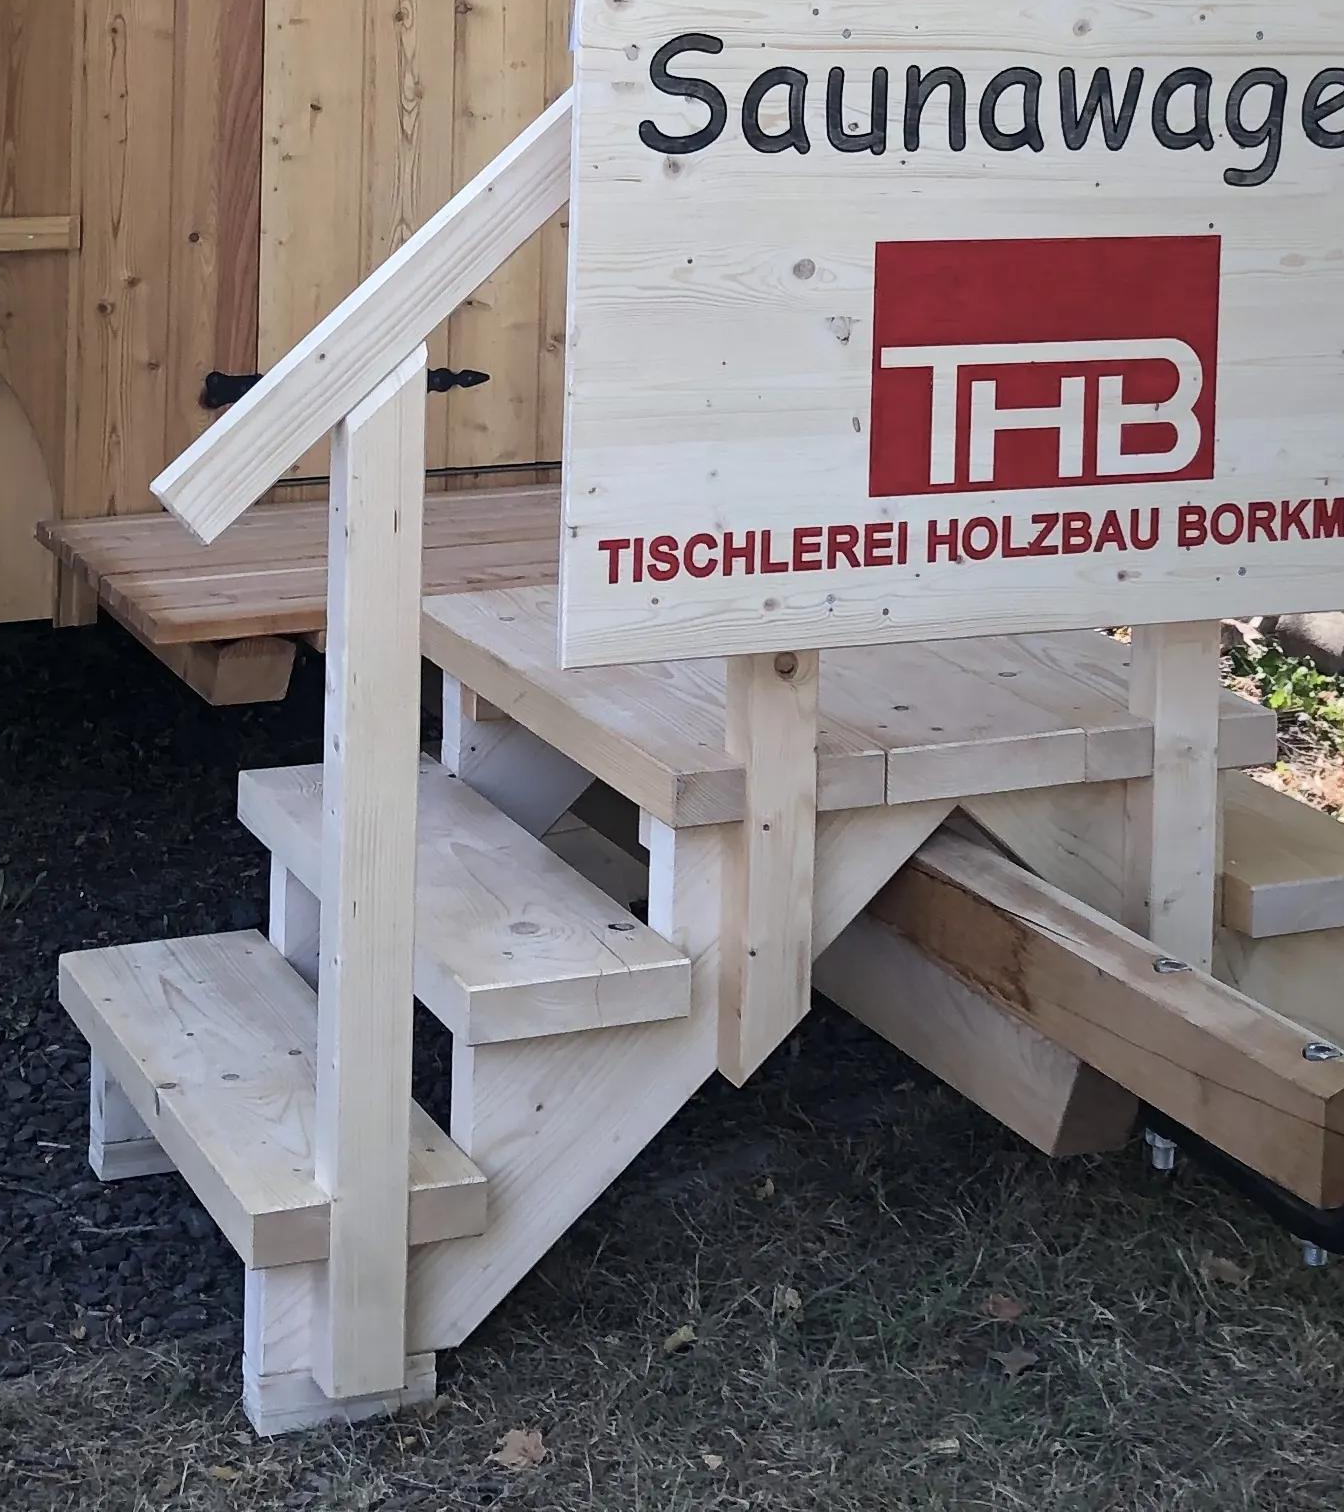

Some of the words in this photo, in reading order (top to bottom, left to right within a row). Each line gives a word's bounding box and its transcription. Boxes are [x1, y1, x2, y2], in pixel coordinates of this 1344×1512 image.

[879, 337, 1204, 487] THB
[598, 521, 908, 585] TISCHLEREI
[927, 507, 1160, 563] HOLZBAU
